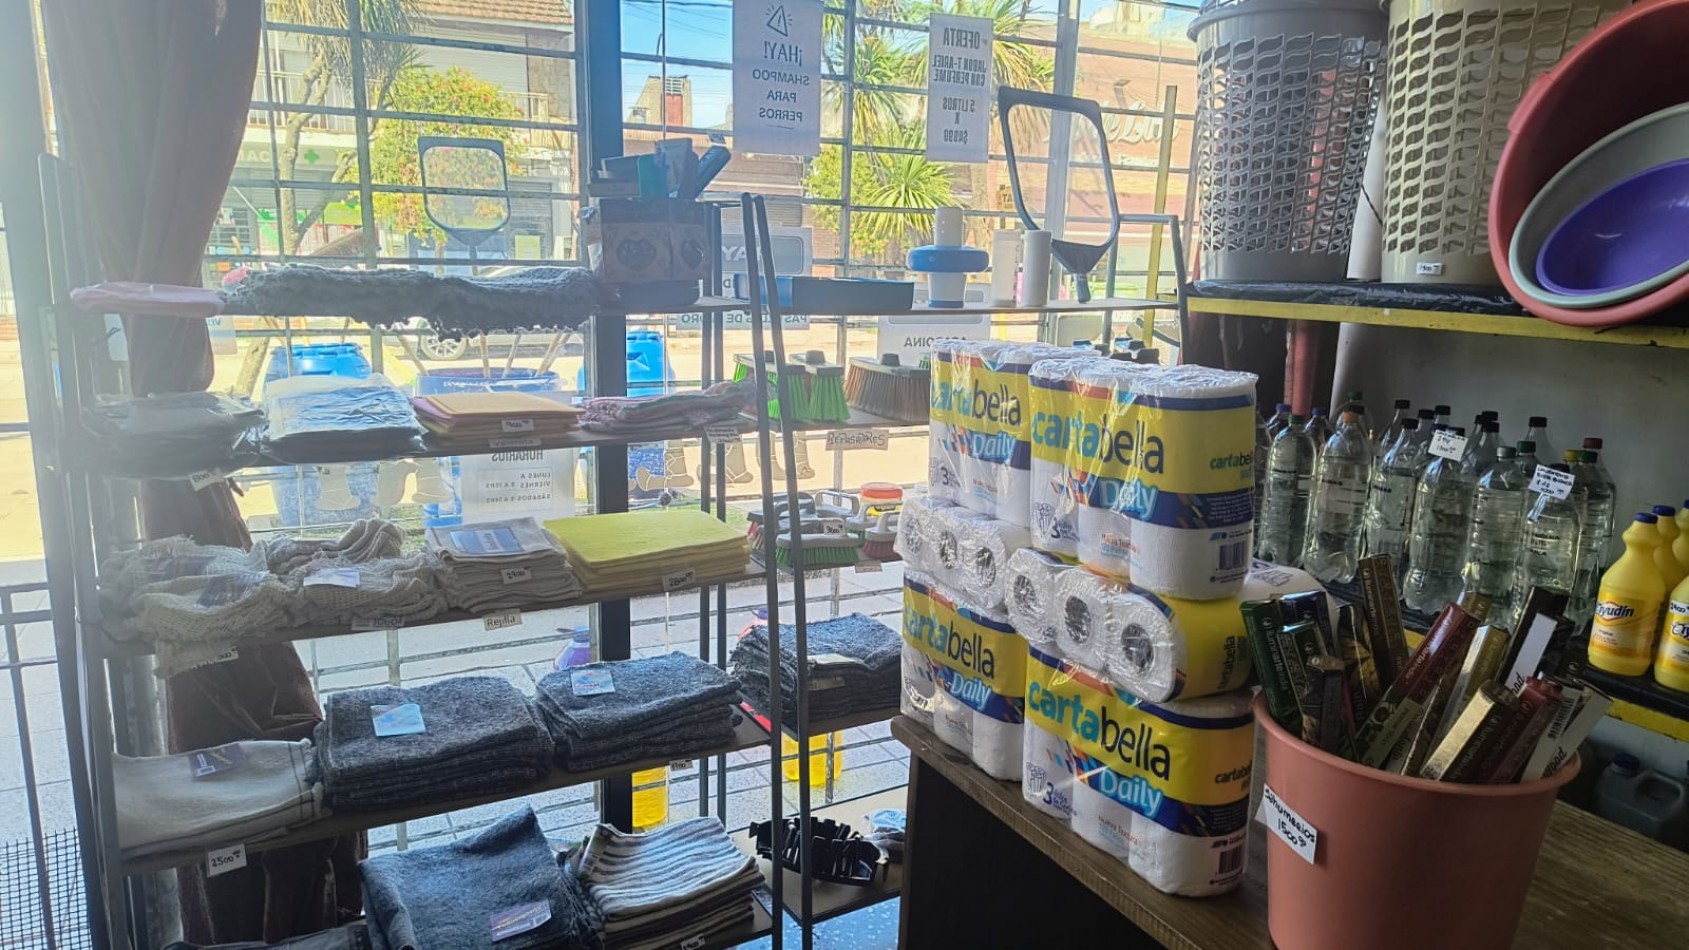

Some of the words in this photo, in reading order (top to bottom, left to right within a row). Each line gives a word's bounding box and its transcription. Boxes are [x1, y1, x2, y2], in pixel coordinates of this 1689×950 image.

[973, 431, 1017, 467] Daily
[1032, 410, 1164, 474] cartabella
[949, 672, 993, 711] Daily
[1028, 681, 1171, 781] cartabella
[1043, 781, 1054, 806] 3
[1100, 768, 1161, 817] Daily
